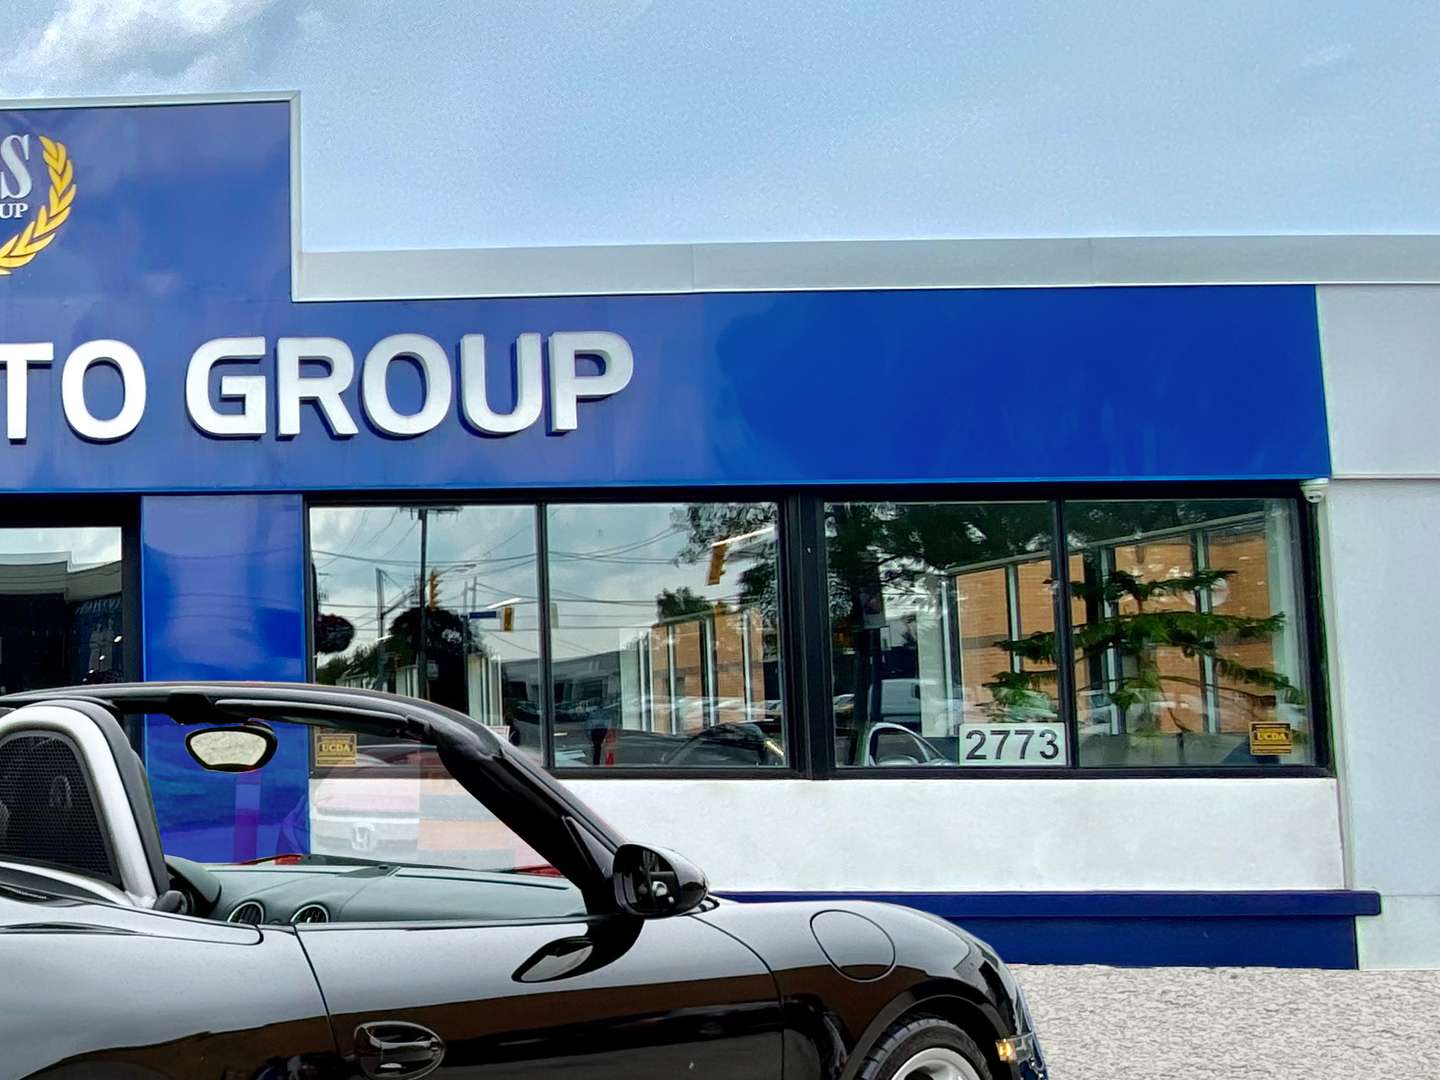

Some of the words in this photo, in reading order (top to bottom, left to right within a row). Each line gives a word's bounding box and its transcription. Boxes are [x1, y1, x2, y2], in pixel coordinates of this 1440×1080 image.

[185, 330, 635, 437] GROUP
[965, 729, 1060, 760] 2773
[1256, 732, 1288, 741] UCDA
[321, 743, 351, 752] UCDA
